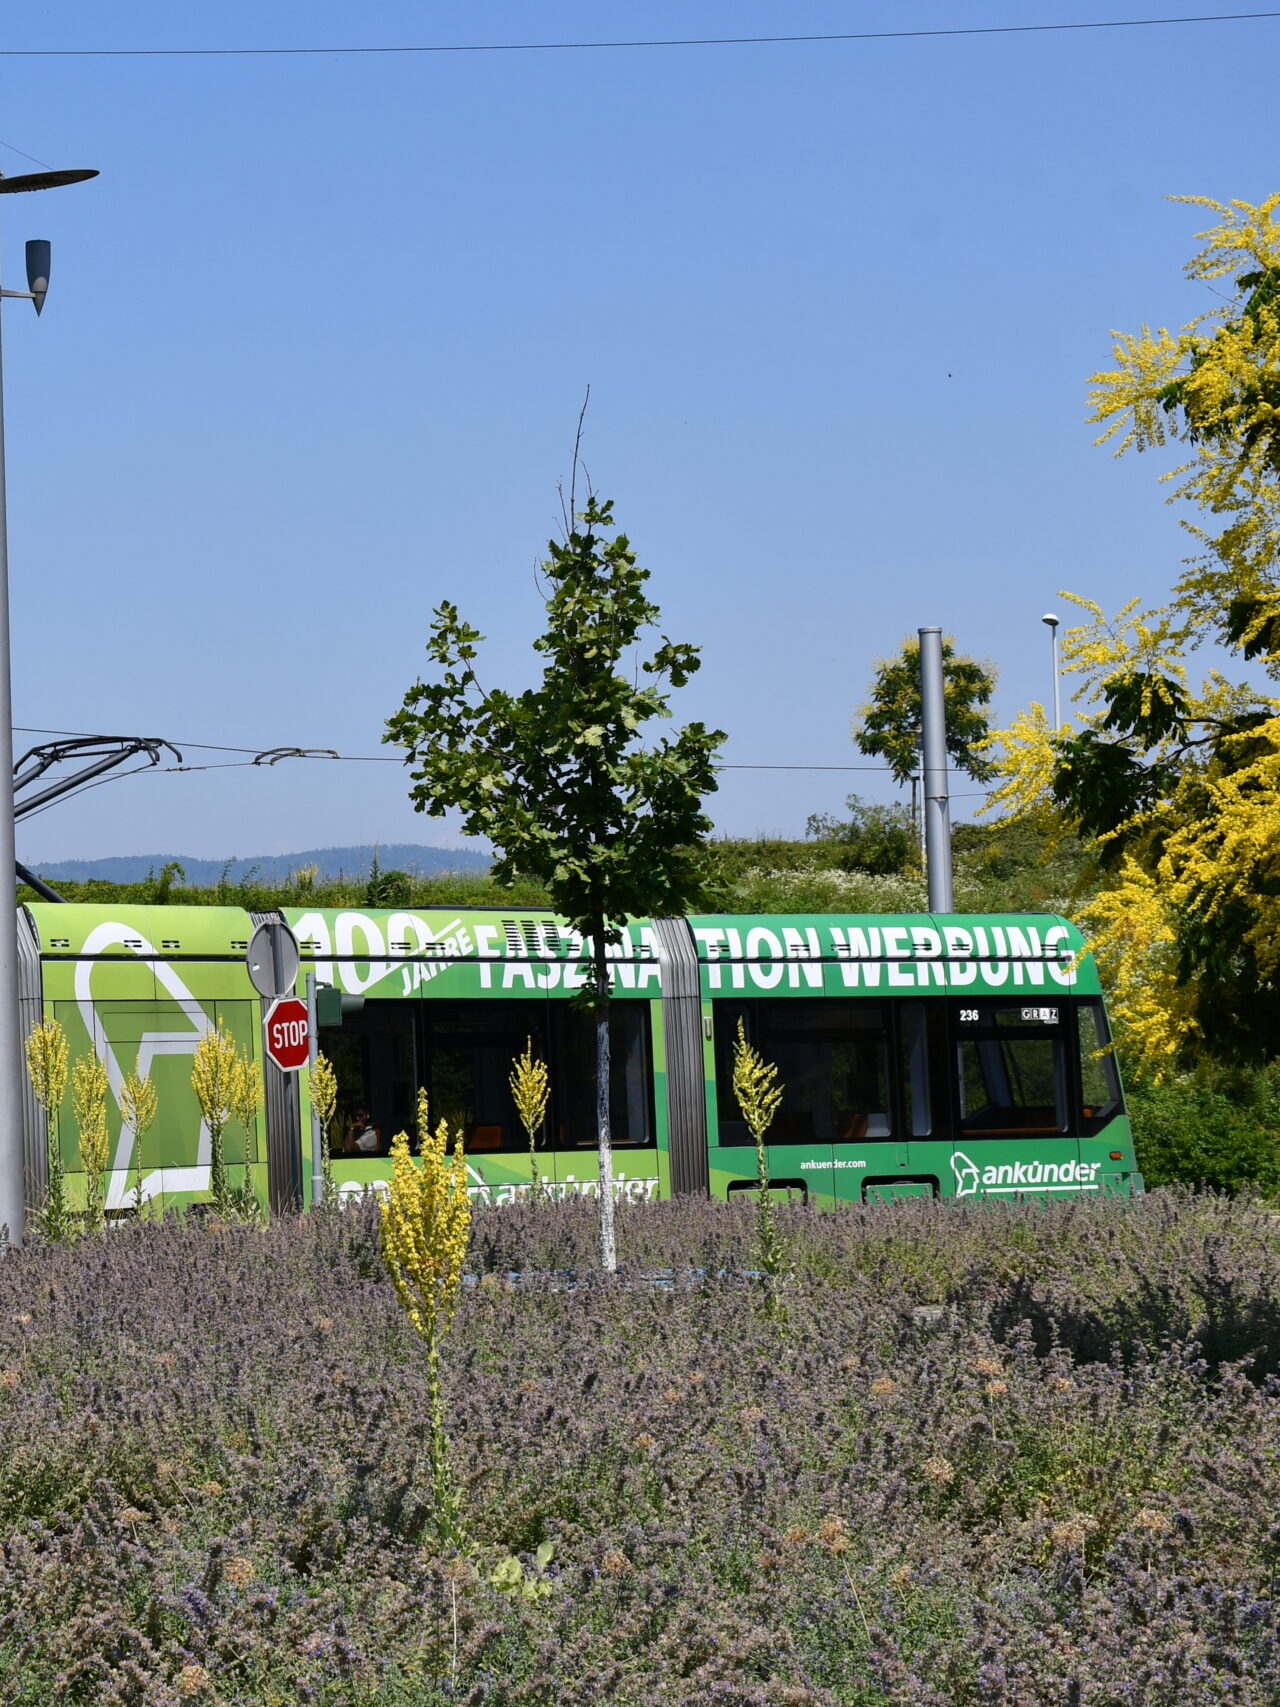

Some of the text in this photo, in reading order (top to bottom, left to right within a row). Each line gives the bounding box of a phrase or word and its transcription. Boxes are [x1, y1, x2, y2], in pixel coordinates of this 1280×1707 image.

[291, 911, 434, 996] 100
[401, 926, 474, 997] JAHRE
[693, 926, 823, 990] TION
[830, 926, 1078, 987] WERBUNG
[959, 1009, 979, 1021] 236
[1021, 1008, 1058, 1020] GRAZ
[273, 1020, 308, 1050] STOP
[800, 1158, 867, 1170] ankuender.com
[982, 1160, 1101, 1185] ankünder
